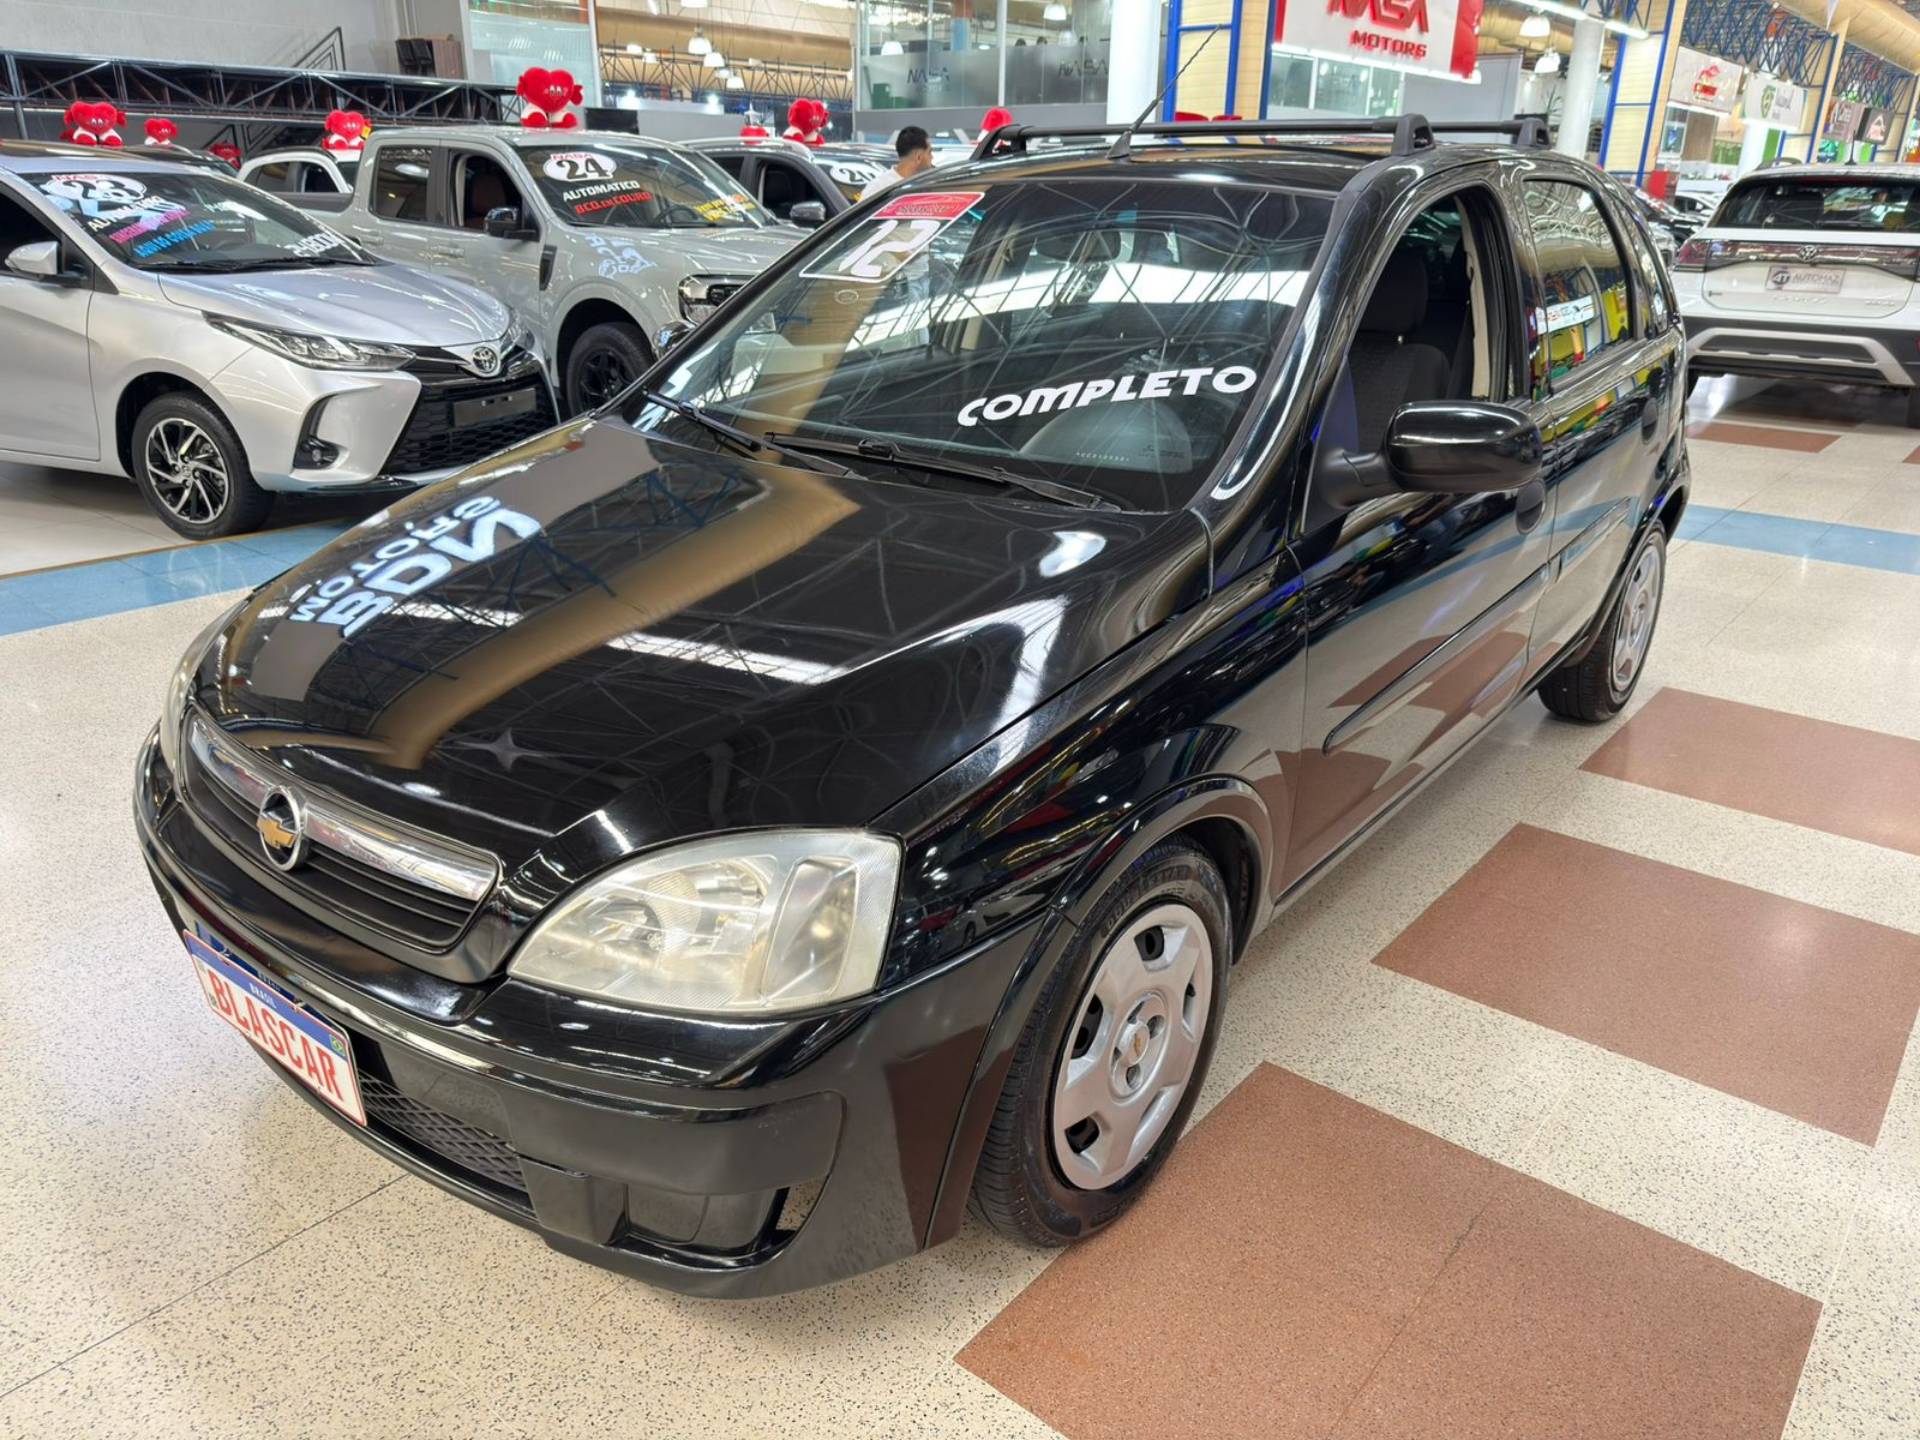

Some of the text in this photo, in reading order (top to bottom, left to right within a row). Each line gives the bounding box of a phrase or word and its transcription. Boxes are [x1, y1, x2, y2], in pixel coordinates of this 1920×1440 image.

[1350, 30, 1428, 58] MOTORS
[556, 157, 611, 180] 24
[562, 180, 641, 203] AUTOMATICO
[838, 219, 941, 278] 12
[957, 365, 1257, 427] COMPLETO
[208, 969, 345, 1101] BLASCAR
